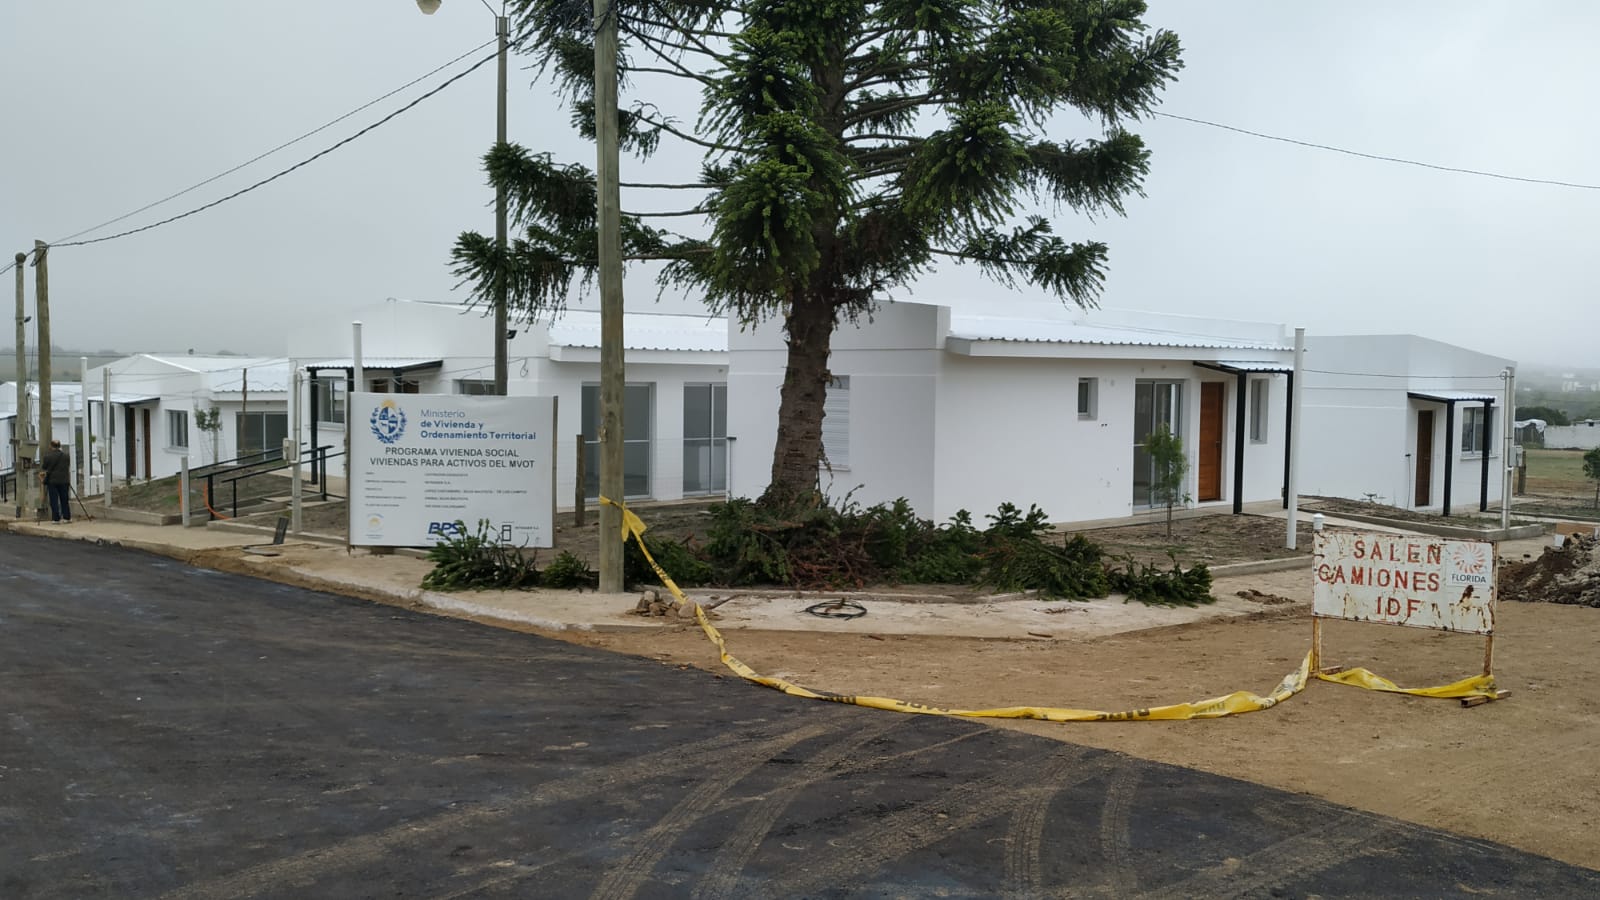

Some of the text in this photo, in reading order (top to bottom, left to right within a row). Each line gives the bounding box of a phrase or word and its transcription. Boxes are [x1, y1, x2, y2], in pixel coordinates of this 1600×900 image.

[420, 409, 466, 418] Ministerio
[420, 420, 484, 430] de Vivienda y
[420, 430, 537, 441] Ordenamiento Territorial
[385, 447, 519, 458] PROGRAMA VIVIENDA SOCIAL
[370, 457, 535, 469] VIVIENDAS PARA ACTIVOS DEL MVOT
[428, 522, 461, 535] BPS
[1353, 539, 1441, 565] SALEN
[1318, 563, 1440, 592] CAMIONES
[1451, 573, 1487, 584] FLORIDA
[1376, 596, 1421, 618] IDF
